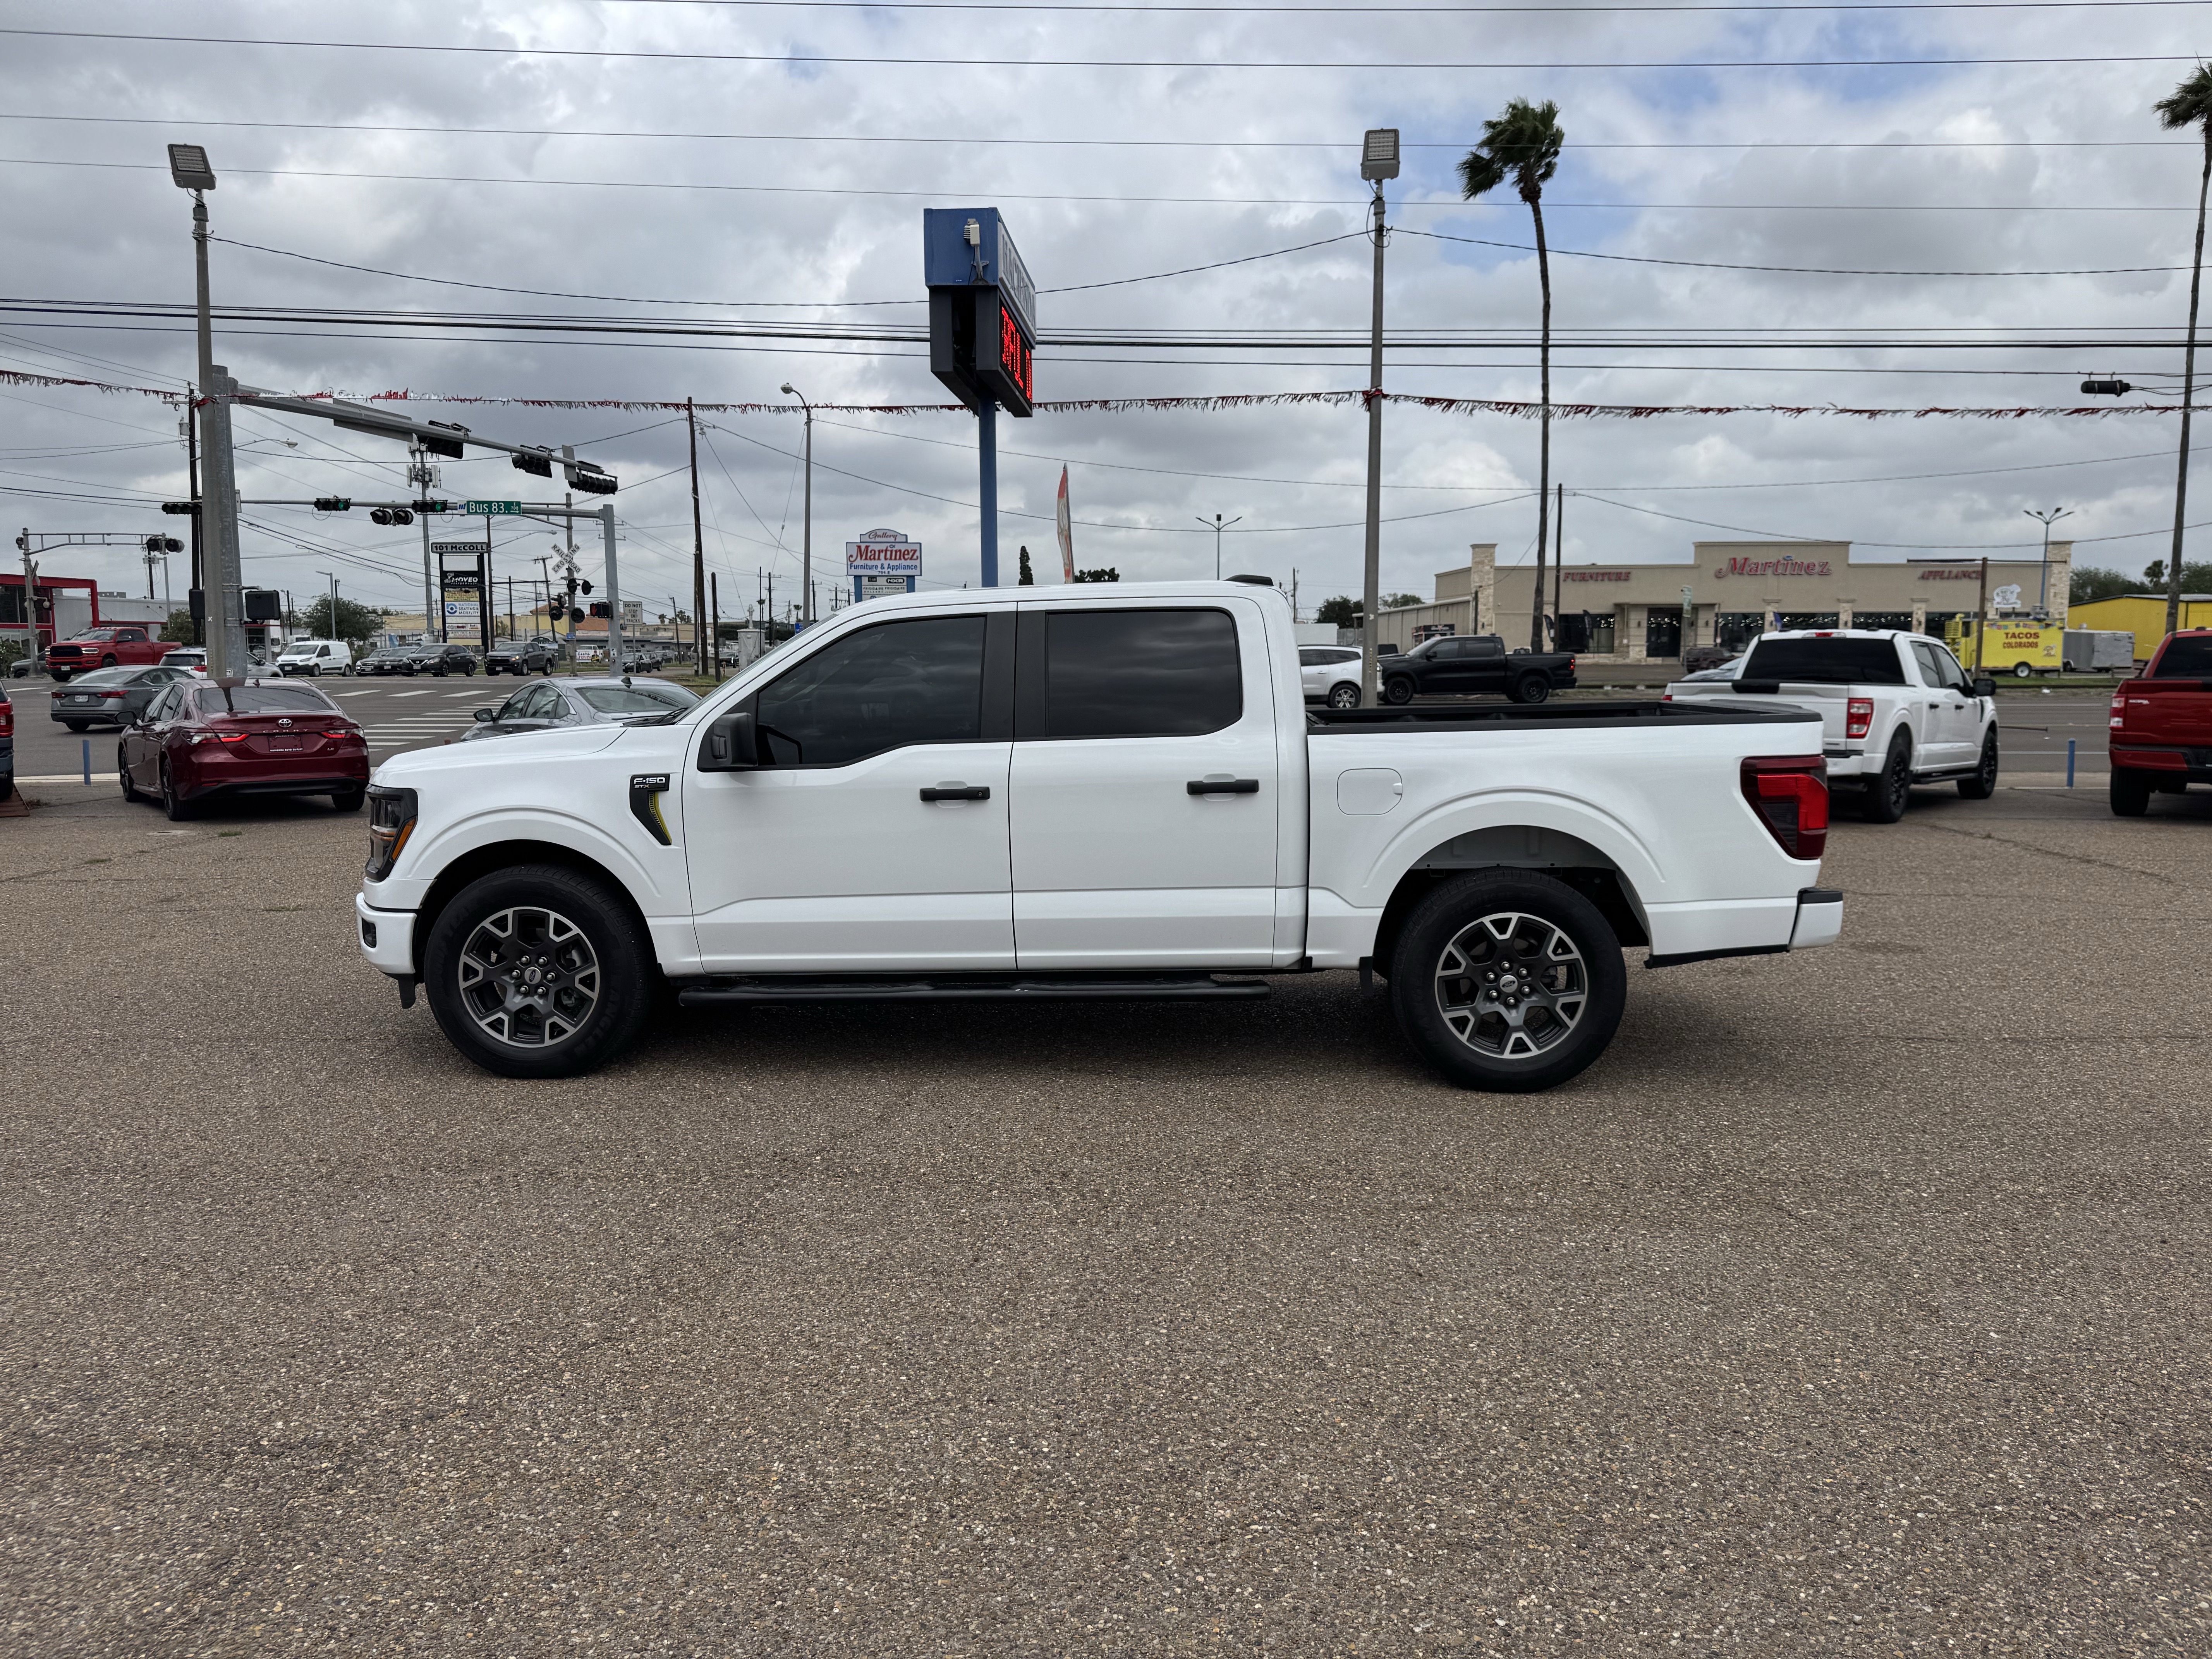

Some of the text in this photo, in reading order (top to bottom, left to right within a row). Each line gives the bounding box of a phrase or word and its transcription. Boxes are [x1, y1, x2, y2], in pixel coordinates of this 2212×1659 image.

[469, 502, 488, 513] Bus
[868, 531, 898, 541] Gallery
[553, 545, 564, 558] RAIL
[848, 545, 919, 563] Martinez
[553, 545, 579, 572] CROSSING
[567, 560, 580, 573] ROAD
[887, 563, 918, 571] Appliance
[1715, 556, 1832, 578] Martinez
[1563, 572, 1631, 582] FURNITURE
